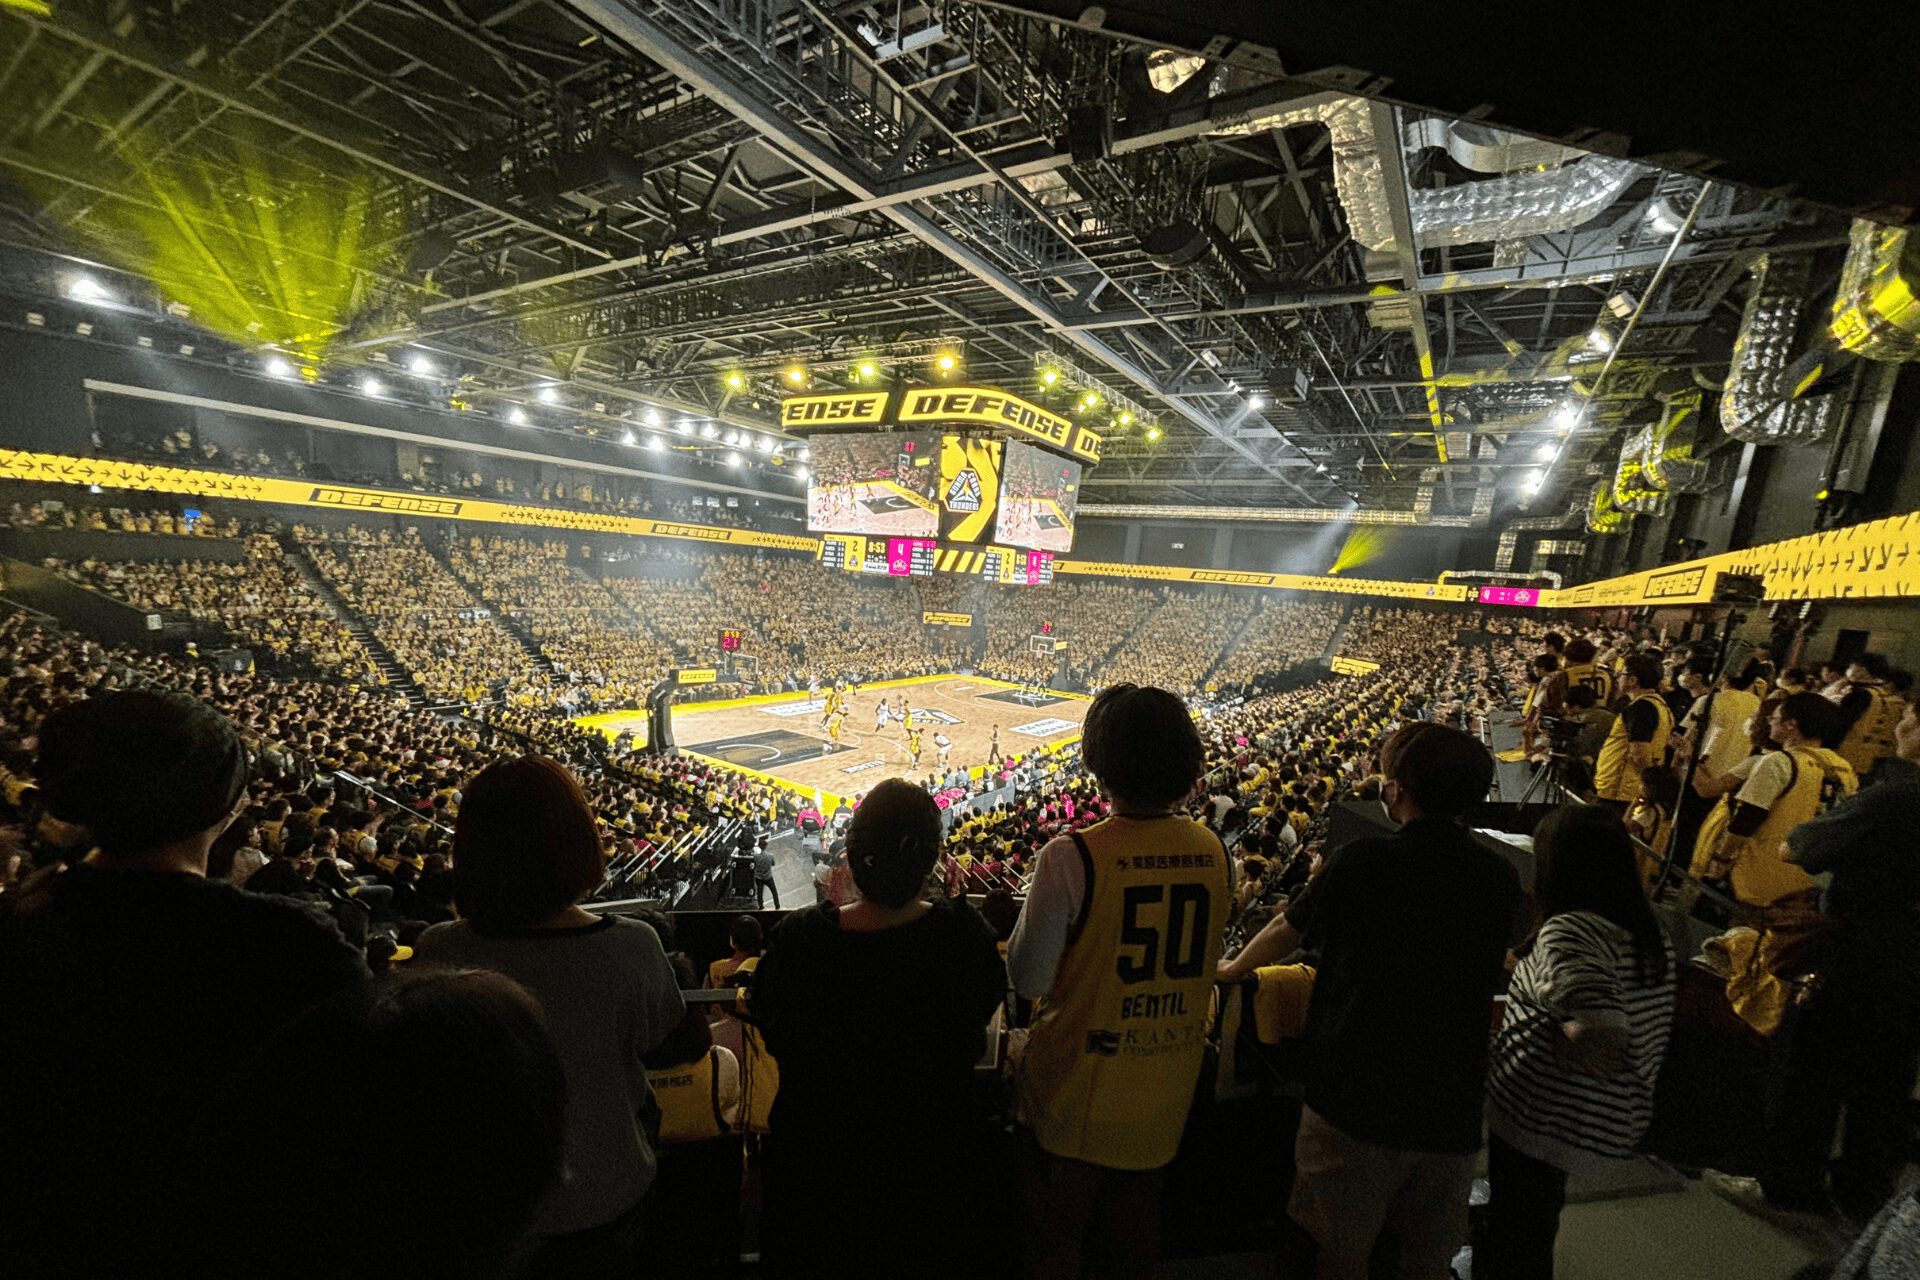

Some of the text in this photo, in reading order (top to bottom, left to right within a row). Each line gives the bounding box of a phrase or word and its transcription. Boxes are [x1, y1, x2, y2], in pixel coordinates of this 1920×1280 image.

[782, 398, 879, 420] ENSE
[912, 394, 1065, 441] DEFENSE
[316, 489, 458, 515] DEFENSE
[654, 524, 730, 541] DEFENSE
[852, 540, 858, 552] 2
[1193, 571, 1273, 585] DEFENSE
[1645, 568, 1706, 598] DEFENSE
[1116, 883, 1210, 984] 50
[1121, 992, 1187, 1019] BENTIL
